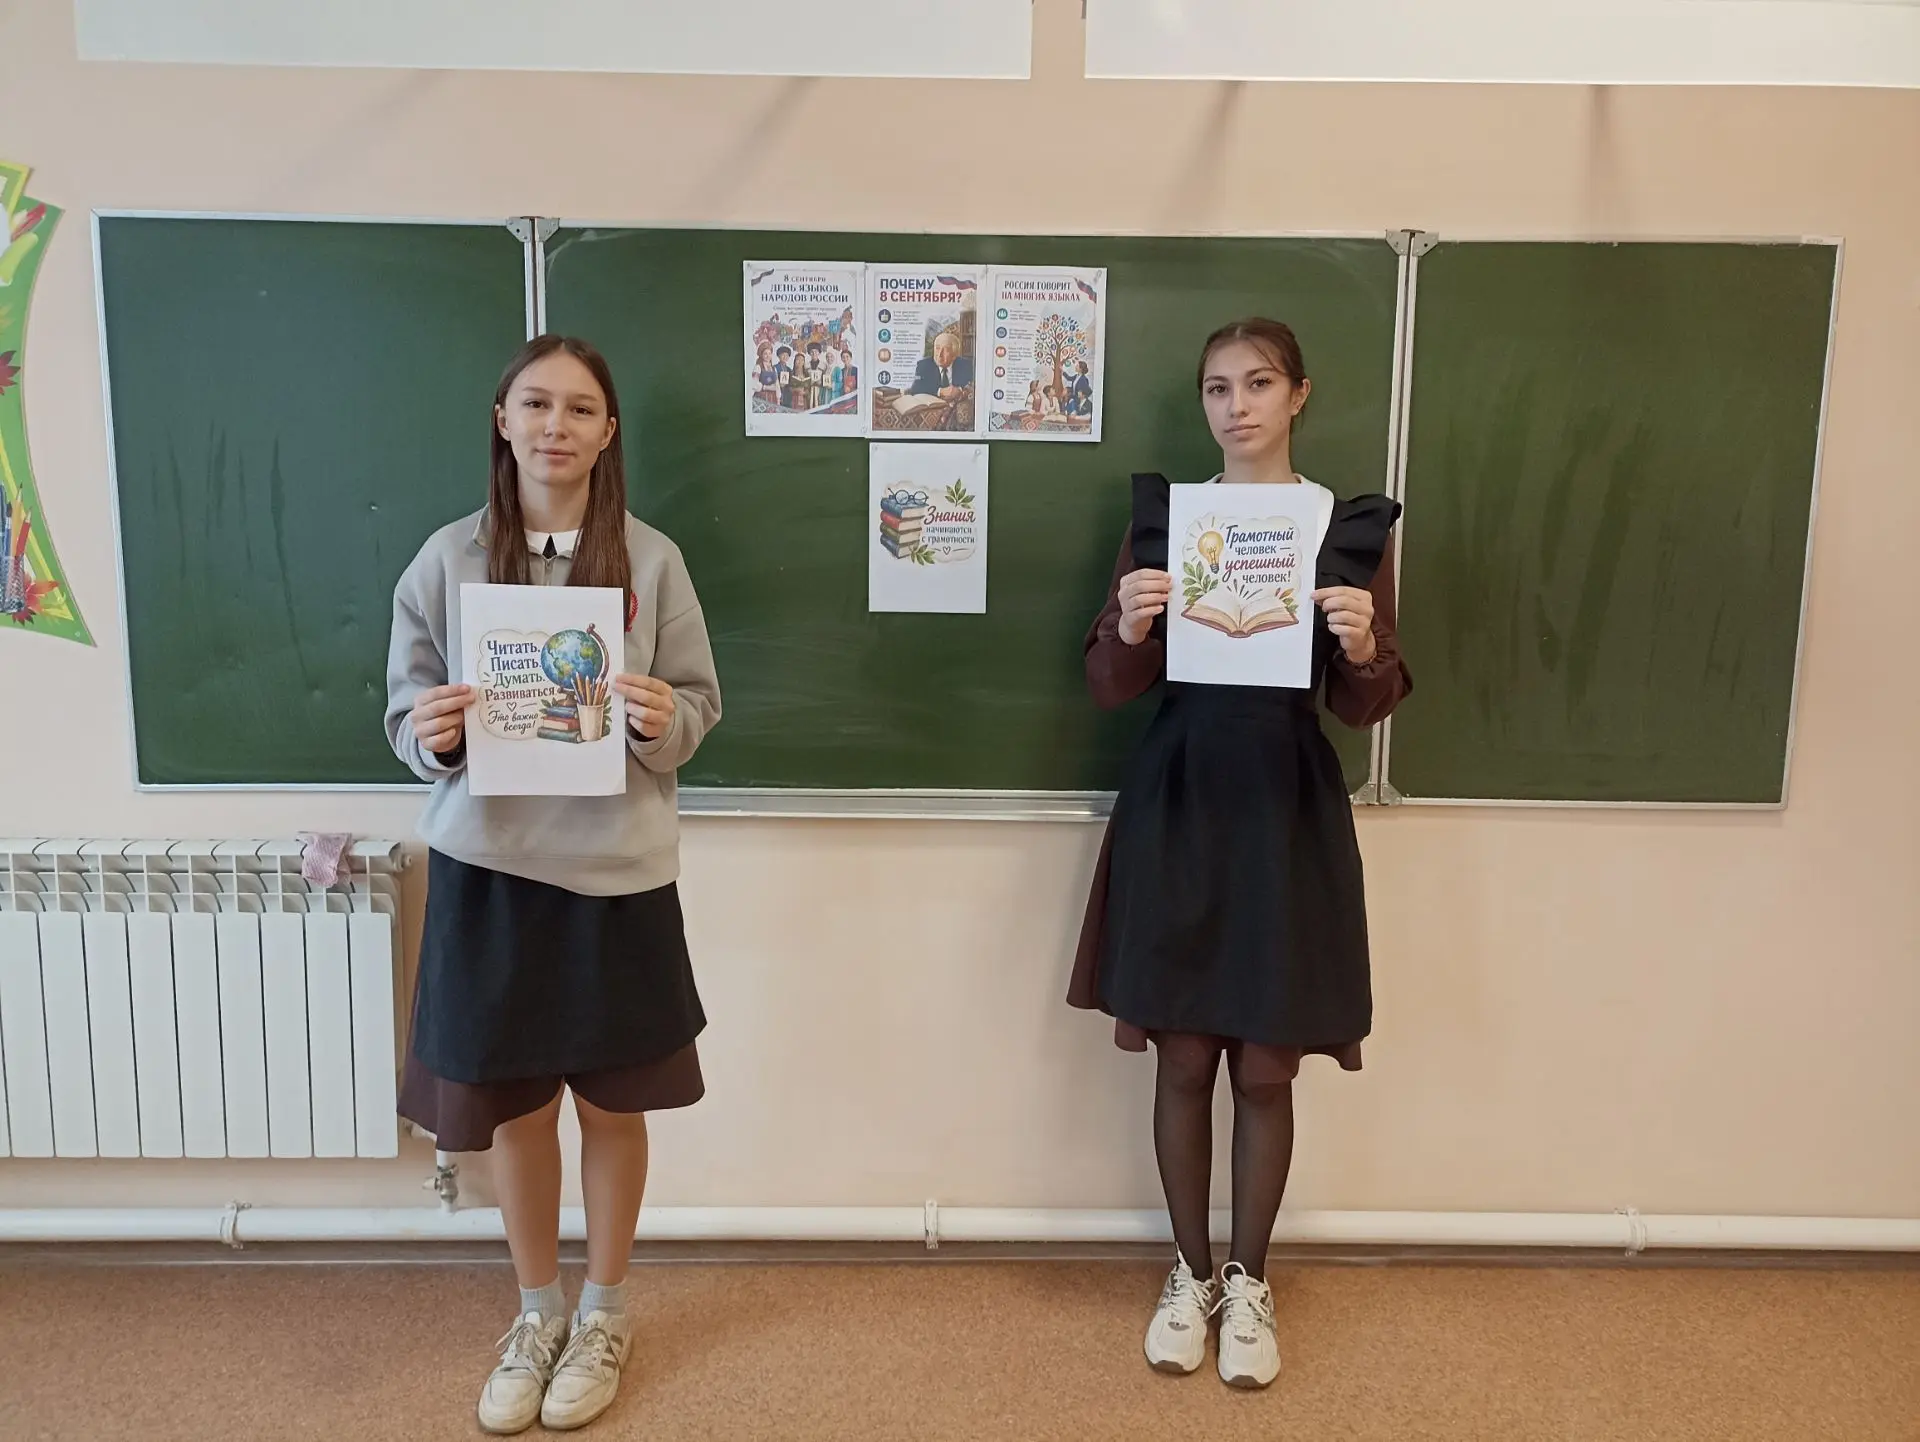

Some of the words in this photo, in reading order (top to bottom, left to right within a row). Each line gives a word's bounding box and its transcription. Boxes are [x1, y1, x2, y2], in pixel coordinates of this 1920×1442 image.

[770, 284, 796, 293] ДЕНЬ
[799, 284, 839, 293] ЯЗЫКОВ
[880, 278, 935, 290] ПОЧЕМУ
[1004, 280, 1036, 290] РОССИЯ
[1037, 281, 1072, 291] ГОВОРИТ
[761, 294, 807, 303] НАРОДОВ
[810, 294, 849, 303] РОССИИ
[880, 291, 888, 302] 8
[891, 291, 962, 303] СЕНТЯБРЯ?
[1001, 291, 1012, 300] НА
[1014, 291, 1046, 301] МНОГИХ
[1048, 292, 1081, 302] ЯЗЫКАХ
[924, 505, 976, 525] Знания
[926, 526, 972, 534] начинаются
[928, 536, 975, 545] грамотности
[1225, 525, 1294, 549] Грамотный
[1235, 545, 1277, 554] человек
[1222, 553, 1296, 583] успешный
[1242, 570, 1292, 583] человек!
[487, 640, 541, 655] Читать.
[490, 657, 542, 672] Писать.
[493, 672, 546, 689] Думать.
[487, 710, 510, 725] Это
[511, 708, 539, 722] важно
[503, 720, 536, 736] всегда!
